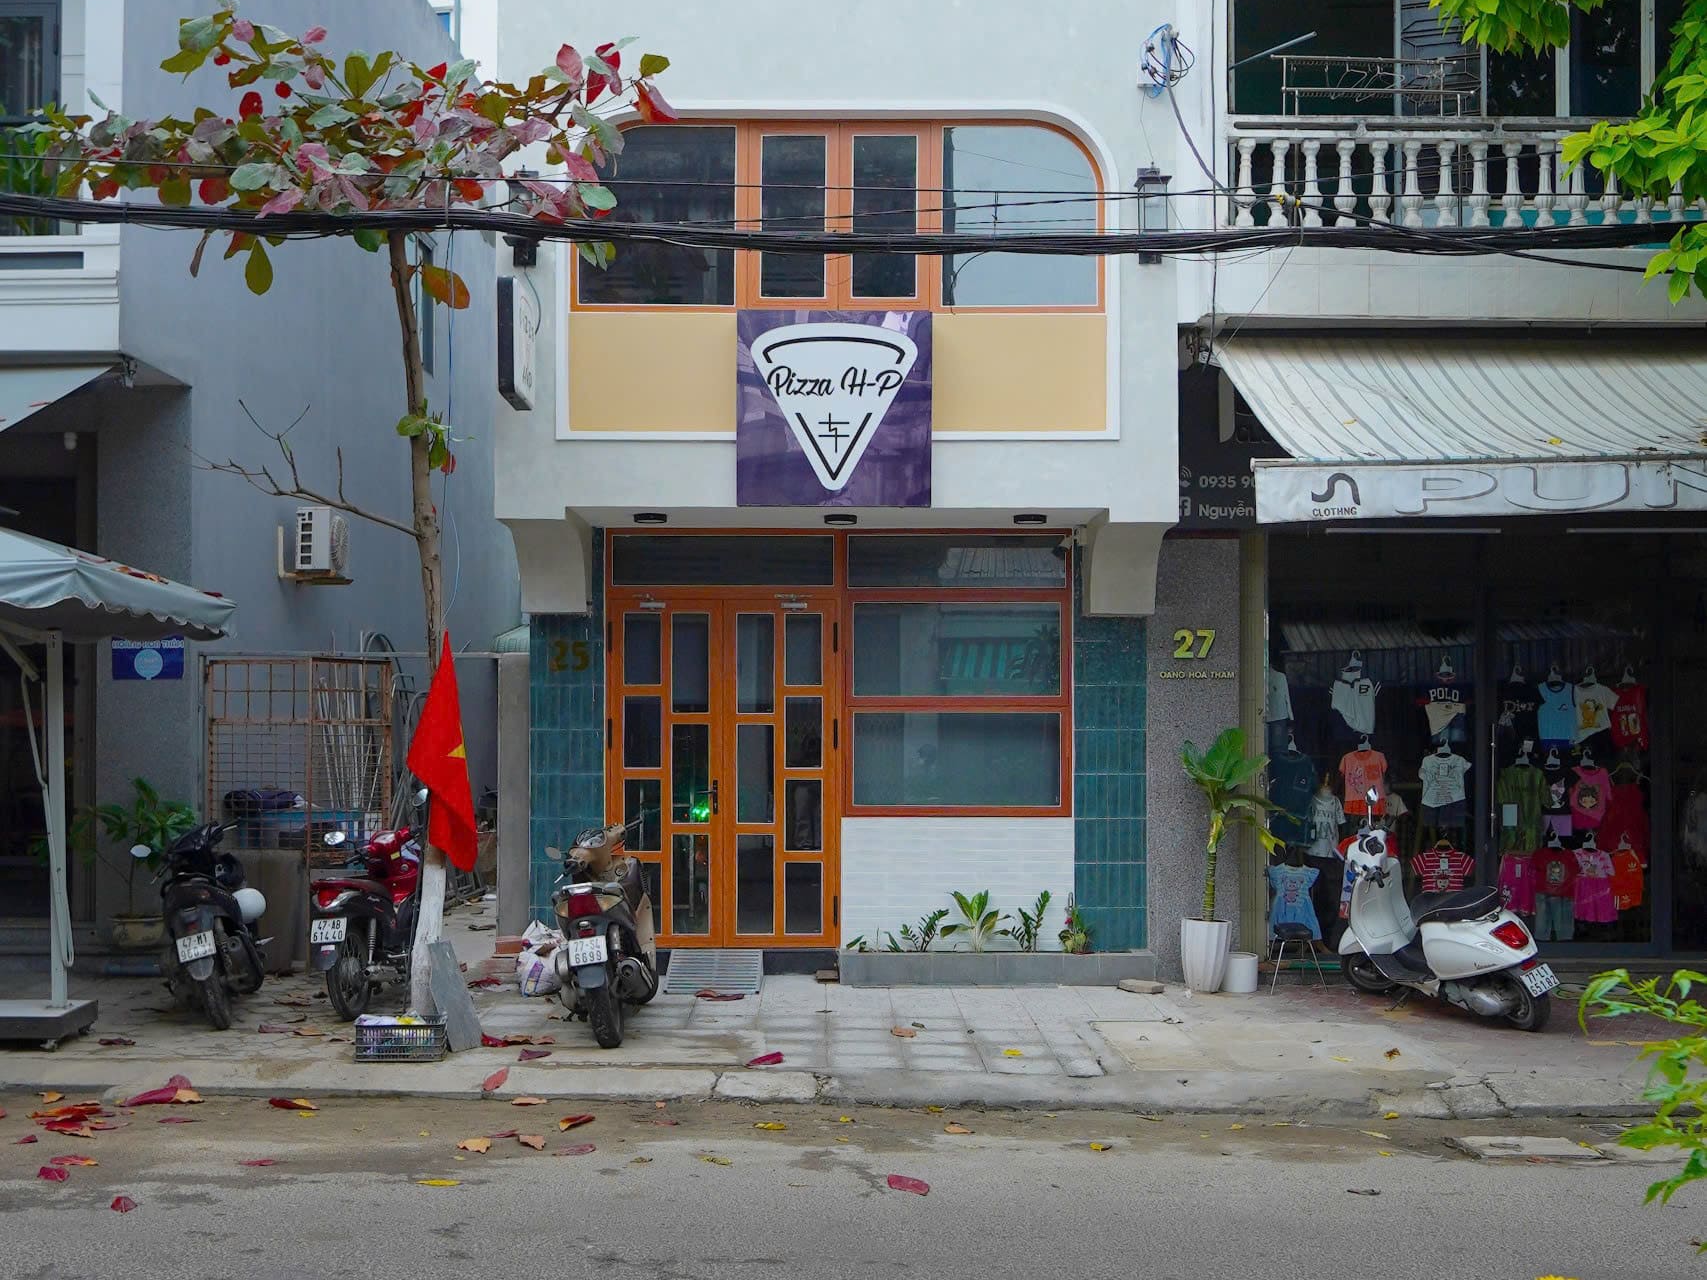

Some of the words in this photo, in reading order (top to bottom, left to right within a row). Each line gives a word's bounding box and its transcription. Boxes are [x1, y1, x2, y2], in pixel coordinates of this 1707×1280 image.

[767, 365, 834, 397] Pizza
[841, 366, 904, 397] H-P
[1199, 475, 1237, 488] 0935
[1312, 507, 1358, 517] CLOTHNG
[1173, 629, 1216, 659] 27
[548, 640, 591, 672] 25
[1429, 687, 1460, 702] POLO
[574, 950, 602, 964] 6699
